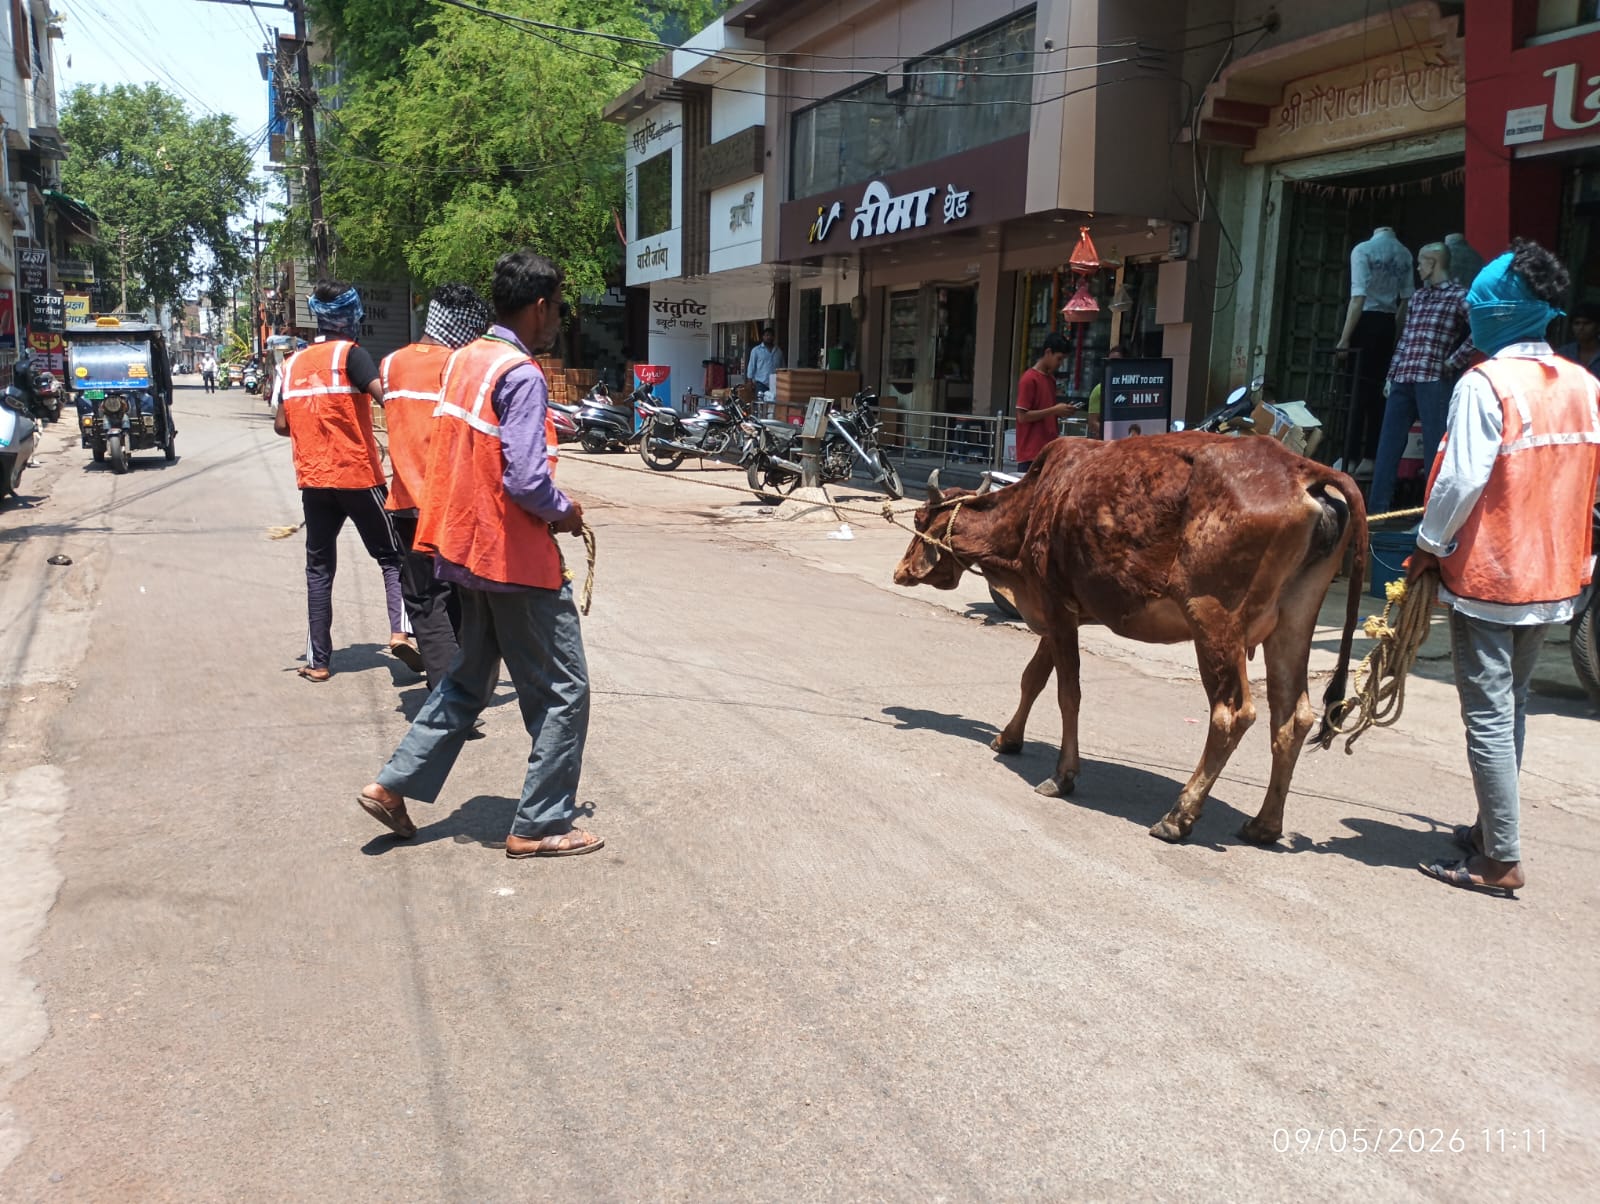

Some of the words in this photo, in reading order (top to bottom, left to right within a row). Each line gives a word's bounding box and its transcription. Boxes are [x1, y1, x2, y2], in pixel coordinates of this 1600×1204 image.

[31, 293, 63, 306] उमंग
[653, 297, 708, 318] संतुष्टि
[1121, 374, 1140, 385] HINT
[1132, 393, 1160, 404] HINT
